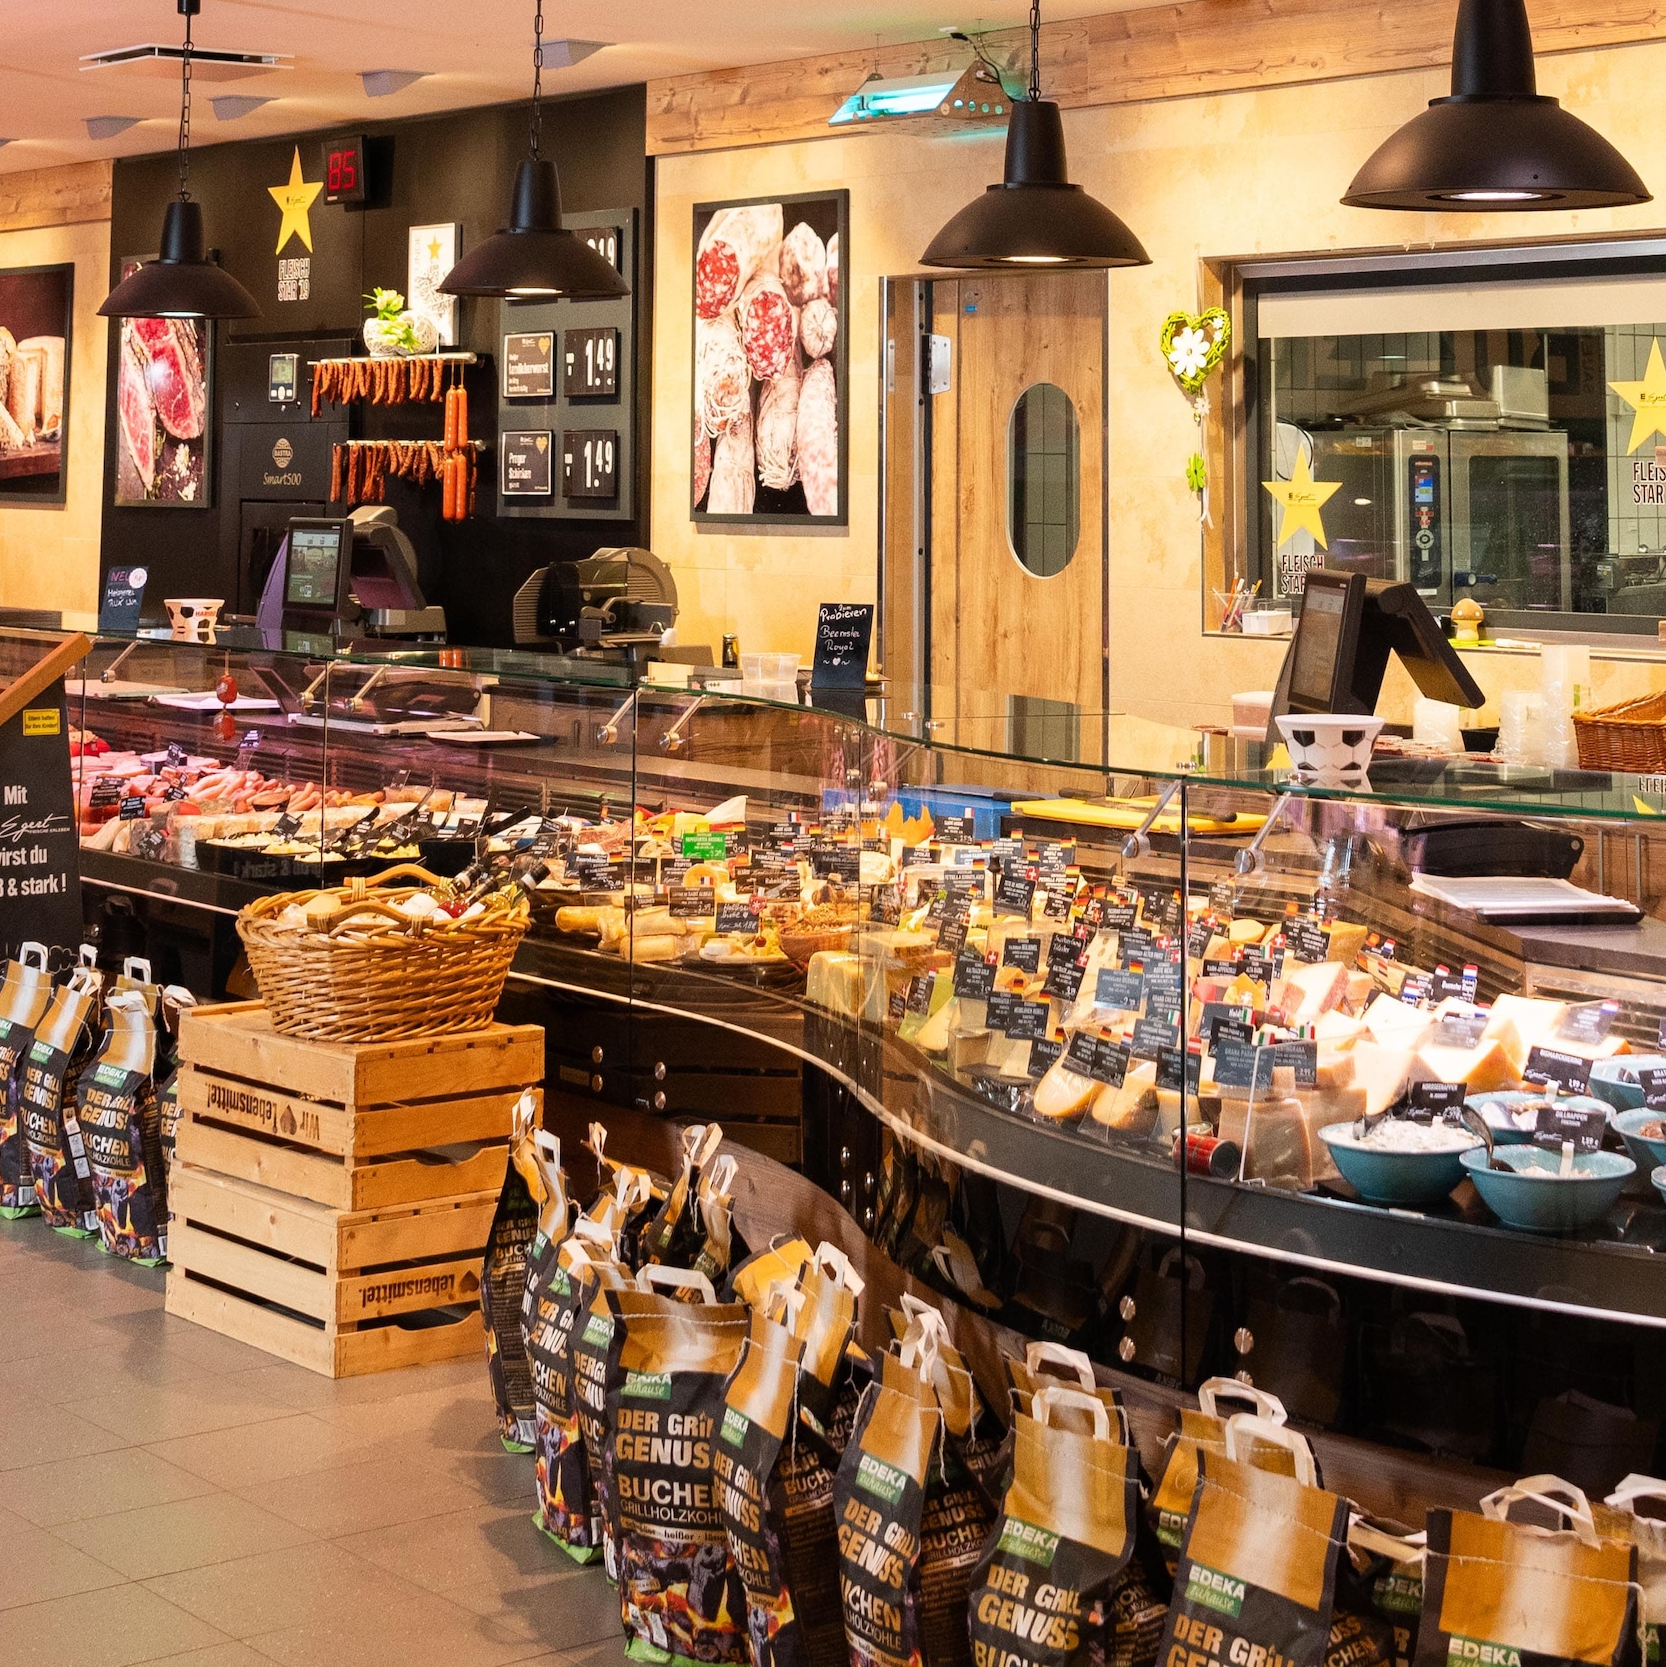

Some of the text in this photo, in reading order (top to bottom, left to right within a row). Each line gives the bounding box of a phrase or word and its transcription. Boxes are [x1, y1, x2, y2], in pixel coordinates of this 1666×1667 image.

[328, 150, 356, 190] 85
[278, 258, 310, 280] FLEISCH
[278, 279, 297, 301] STAR
[263, 472, 302, 486] Smart500
[1633, 484, 1664, 505] STAR
[1281, 554, 1325, 575] FLEISCH
[820, 607, 867, 623] Probieren
[4, 786, 28, 805] Mit
[30, 845, 48, 864] du
[8, 879, 18, 897] &
[21, 874, 59, 896] stark
[33, 1041, 54, 1056] EDEKA
[98, 1064, 127, 1081] EDEKA
[23, 1085, 59, 1111] GENUSS
[86, 1088, 109, 1107] DER
[299, 1111, 320, 1141] Wir
[617, 1408, 659, 1432] DER
[724, 1407, 749, 1433] EDEKA
[713, 1449, 733, 1479] DER
[860, 1454, 908, 1490] EDEKA
[843, 1497, 882, 1536] DER
[664, 1529, 694, 1542] heißer
[1003, 1519, 1060, 1551] EDEKA
[838, 1523, 904, 1590] GENUSS
[987, 1564, 1030, 1599] DER
[1189, 1564, 1246, 1602] EDEKA
[977, 1593, 1080, 1651] GENUSS
[1174, 1613, 1224, 1654] DER
[1449, 1638, 1521, 1667] EDEKA
